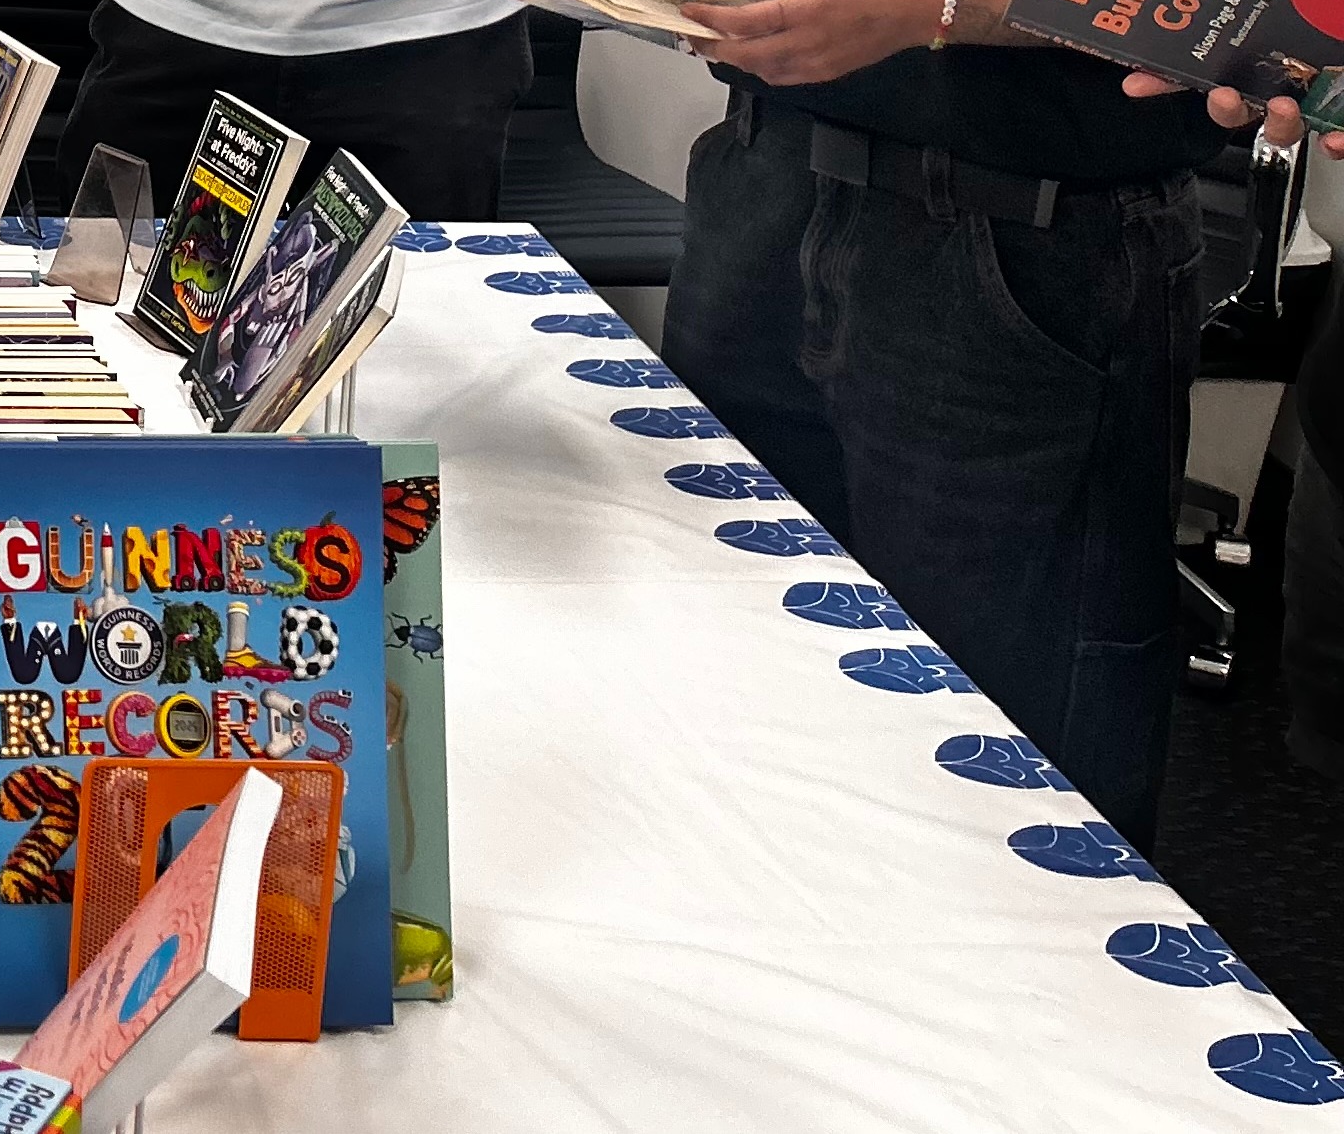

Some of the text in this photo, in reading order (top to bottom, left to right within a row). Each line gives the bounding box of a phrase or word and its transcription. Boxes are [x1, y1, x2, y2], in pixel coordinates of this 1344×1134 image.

[1190, 26, 1220, 61] Alison
[1208, 4, 1237, 30] Page
[217, 116, 237, 139] Five
[235, 128, 265, 157] Nights
[211, 139, 257, 177] at Freddy's
[0, 597, 341, 685] WORLD
[102, 610, 155, 632] GUINNESS
[97, 638, 162, 679] WORLD RECORDS
